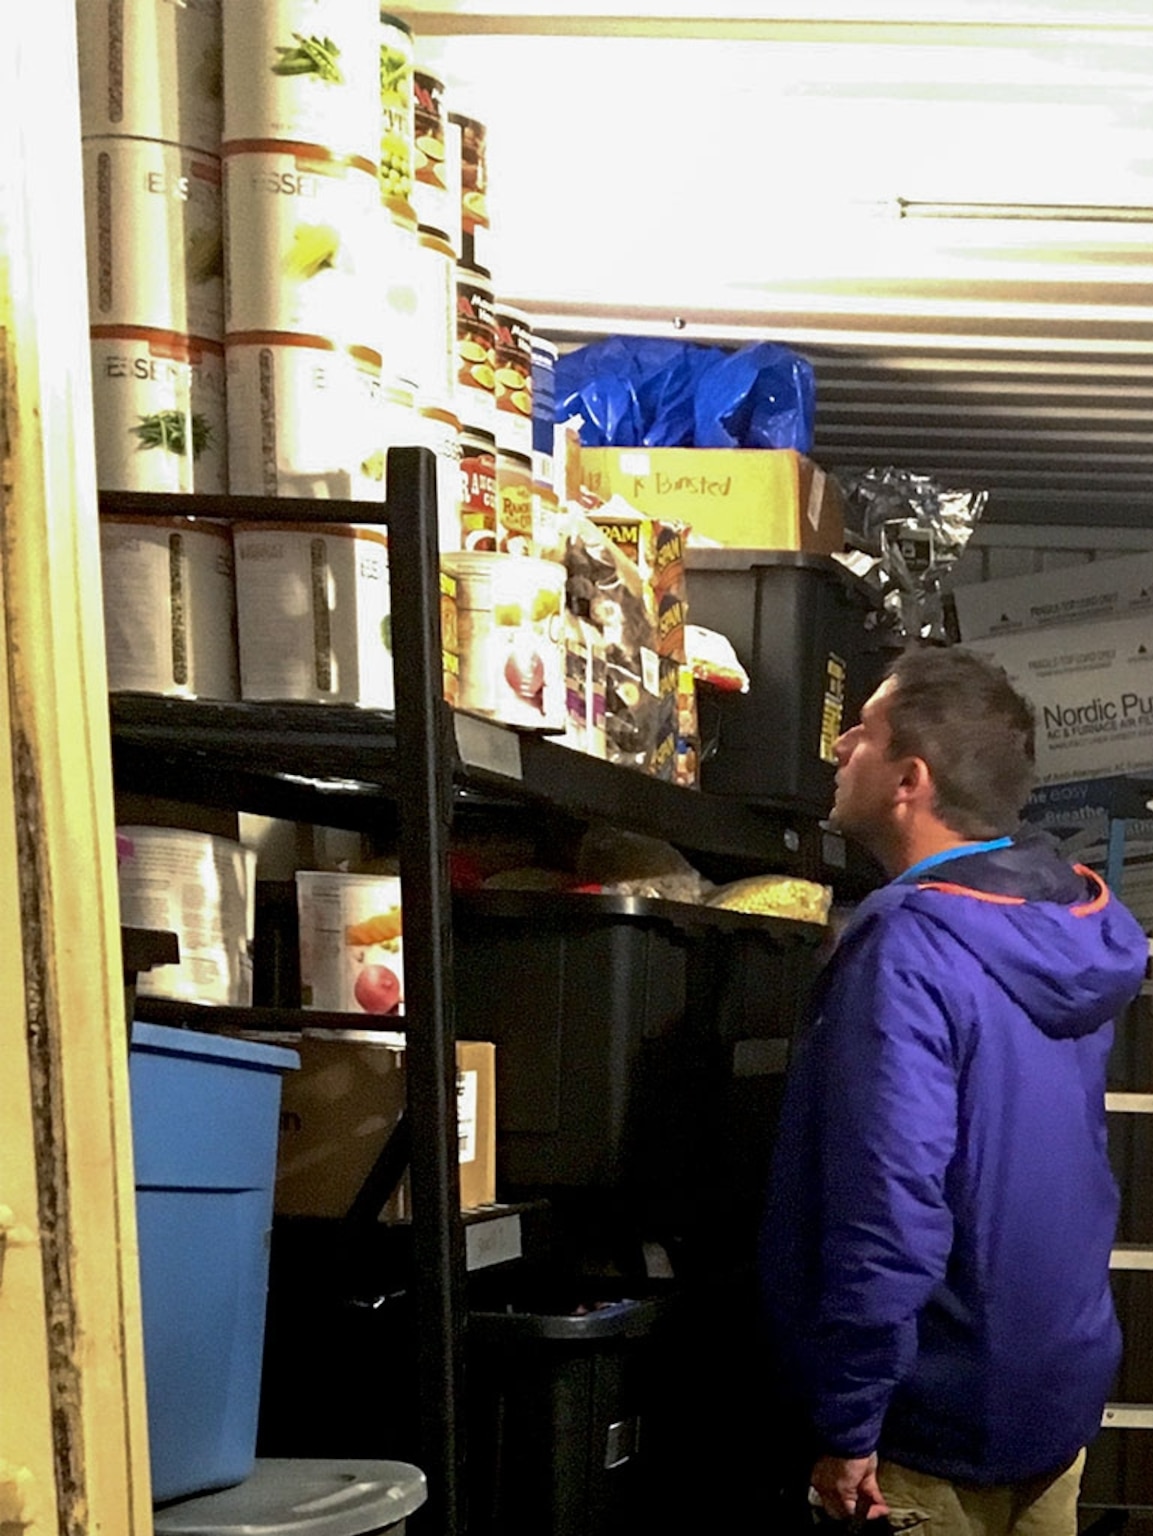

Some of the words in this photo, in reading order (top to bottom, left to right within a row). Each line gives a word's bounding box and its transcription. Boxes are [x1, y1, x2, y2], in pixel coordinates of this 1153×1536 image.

[1042, 696, 1119, 731] Nordic
[1046, 728, 1063, 741] AC
[1072, 719, 1120, 737] FURNACE
[1119, 716, 1138, 731] AIR
